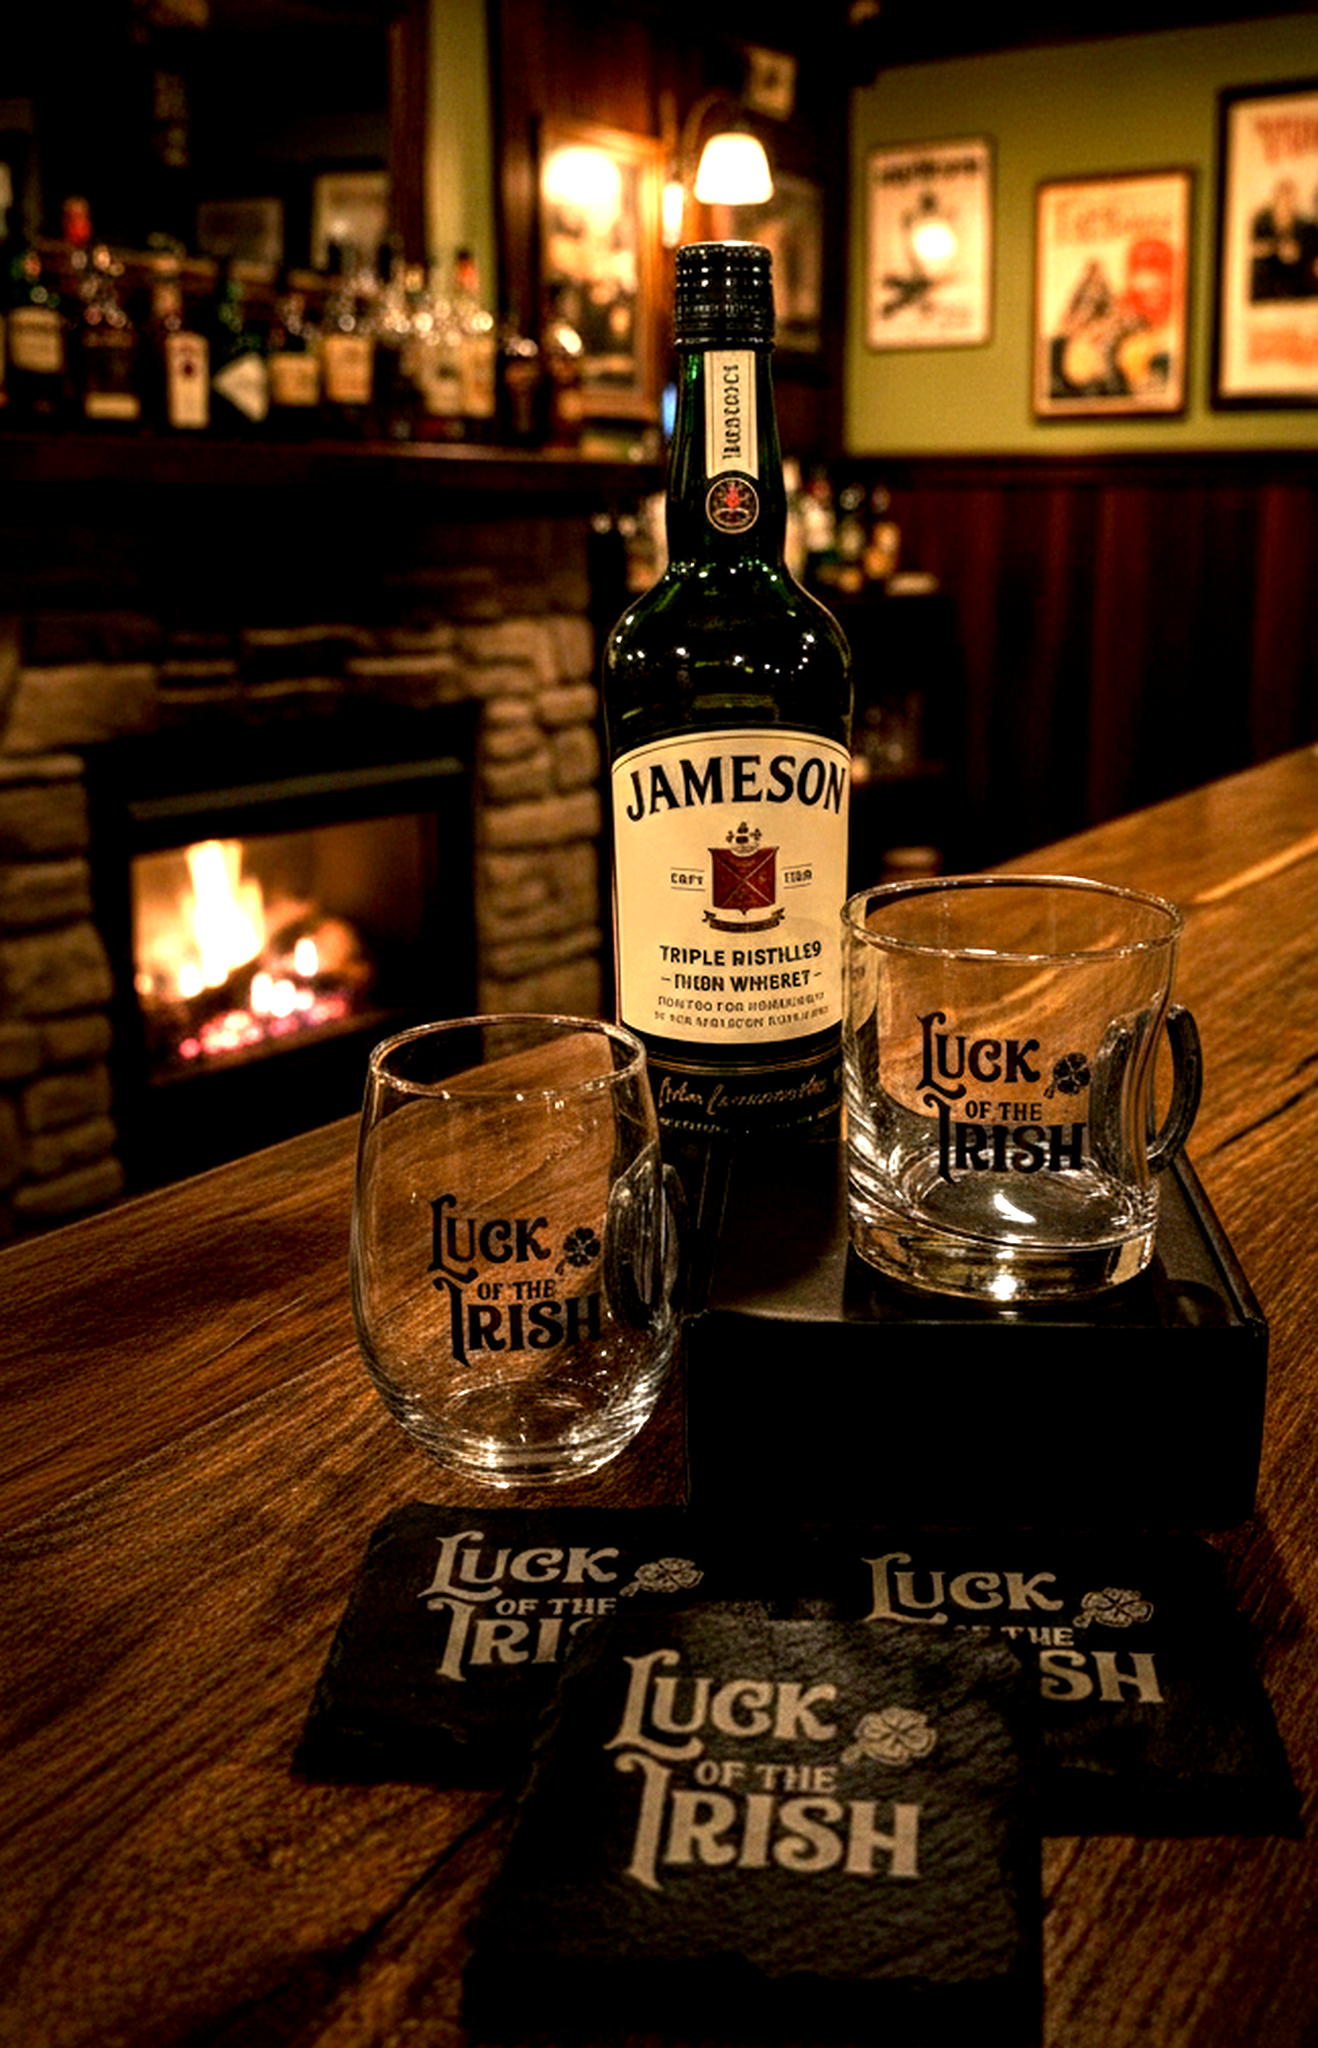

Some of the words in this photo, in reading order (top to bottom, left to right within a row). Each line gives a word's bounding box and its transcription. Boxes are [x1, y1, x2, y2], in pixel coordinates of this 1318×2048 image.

[627, 755, 846, 822] JAMESON
[659, 944, 726, 967] TRIPLE
[915, 1011, 1041, 1100] LUCK
[923, 1093, 1087, 1184] IRISH
[965, 1100, 992, 1119] OF
[999, 1102, 1042, 1121] THE
[428, 1194, 552, 1284] LUCK
[433, 1276, 601, 1368] IRISH
[477, 1282, 504, 1301] OF
[512, 1279, 556, 1300] THE
[417, 1530, 620, 1601] LUCK
[860, 1552, 1064, 1625] LUCK
[427, 1597, 593, 1682] IRI
[495, 1597, 539, 1616] OF
[547, 1597, 618, 1616] THE
[1000, 1626, 1075, 1647] THE
[603, 1649, 838, 1761] LUCK
[695, 1759, 747, 1787] OF
[755, 1763, 838, 1794] THE
[614, 1752, 920, 1891] IRISH
